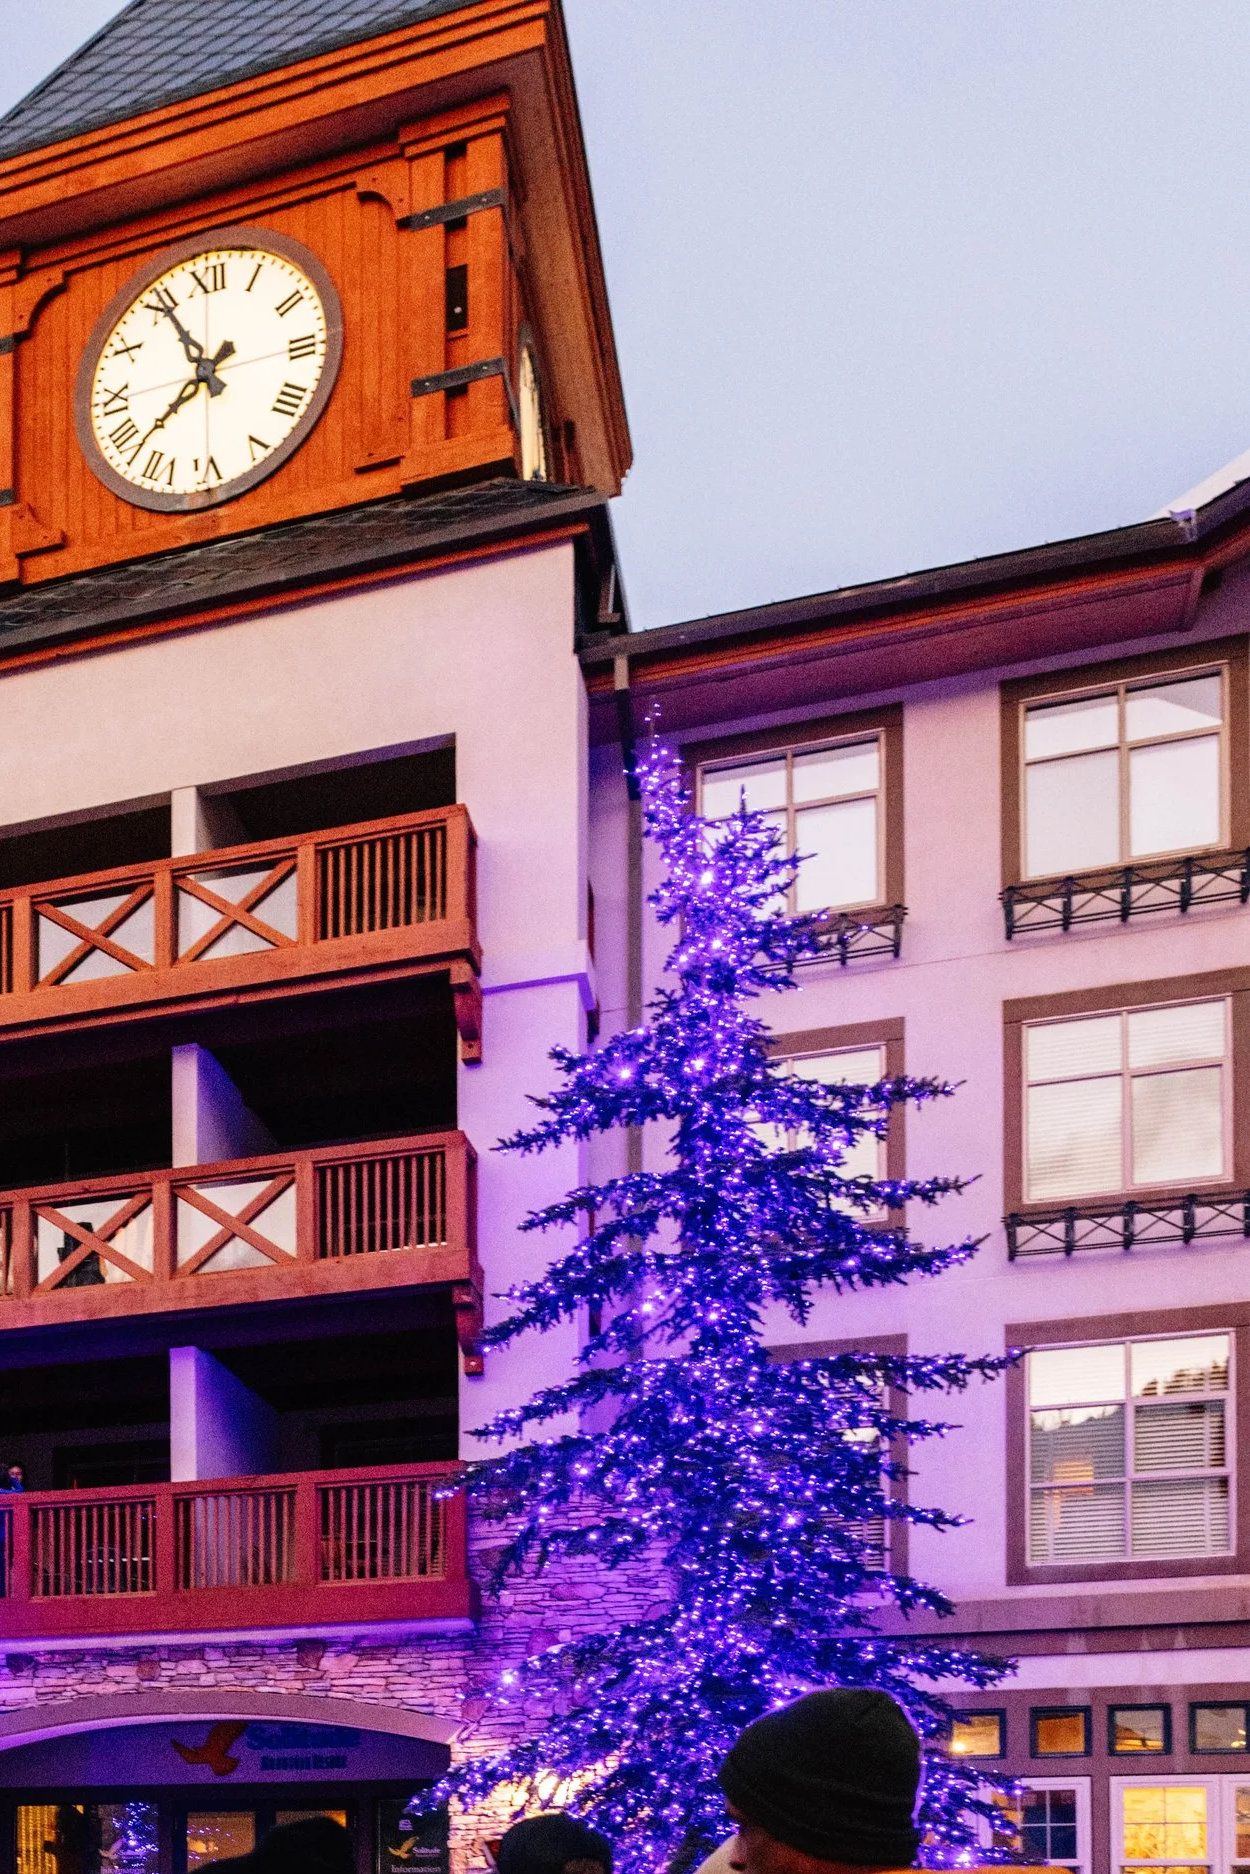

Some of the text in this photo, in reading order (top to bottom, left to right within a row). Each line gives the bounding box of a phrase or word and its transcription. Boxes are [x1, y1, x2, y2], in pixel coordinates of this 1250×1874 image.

[189, 262, 226, 298] XII
[244, 263, 263, 292] I
[275, 289, 304, 317] II
[113, 337, 143, 363] X
[289, 334, 316, 361] III
[103, 382, 129, 417] IX
[271, 382, 307, 417] IIII
[109, 418, 145, 466] VIII
[247, 434, 272, 462] V
[141, 450, 176, 486] VII
[391, 1864, 442, 1873] Information
